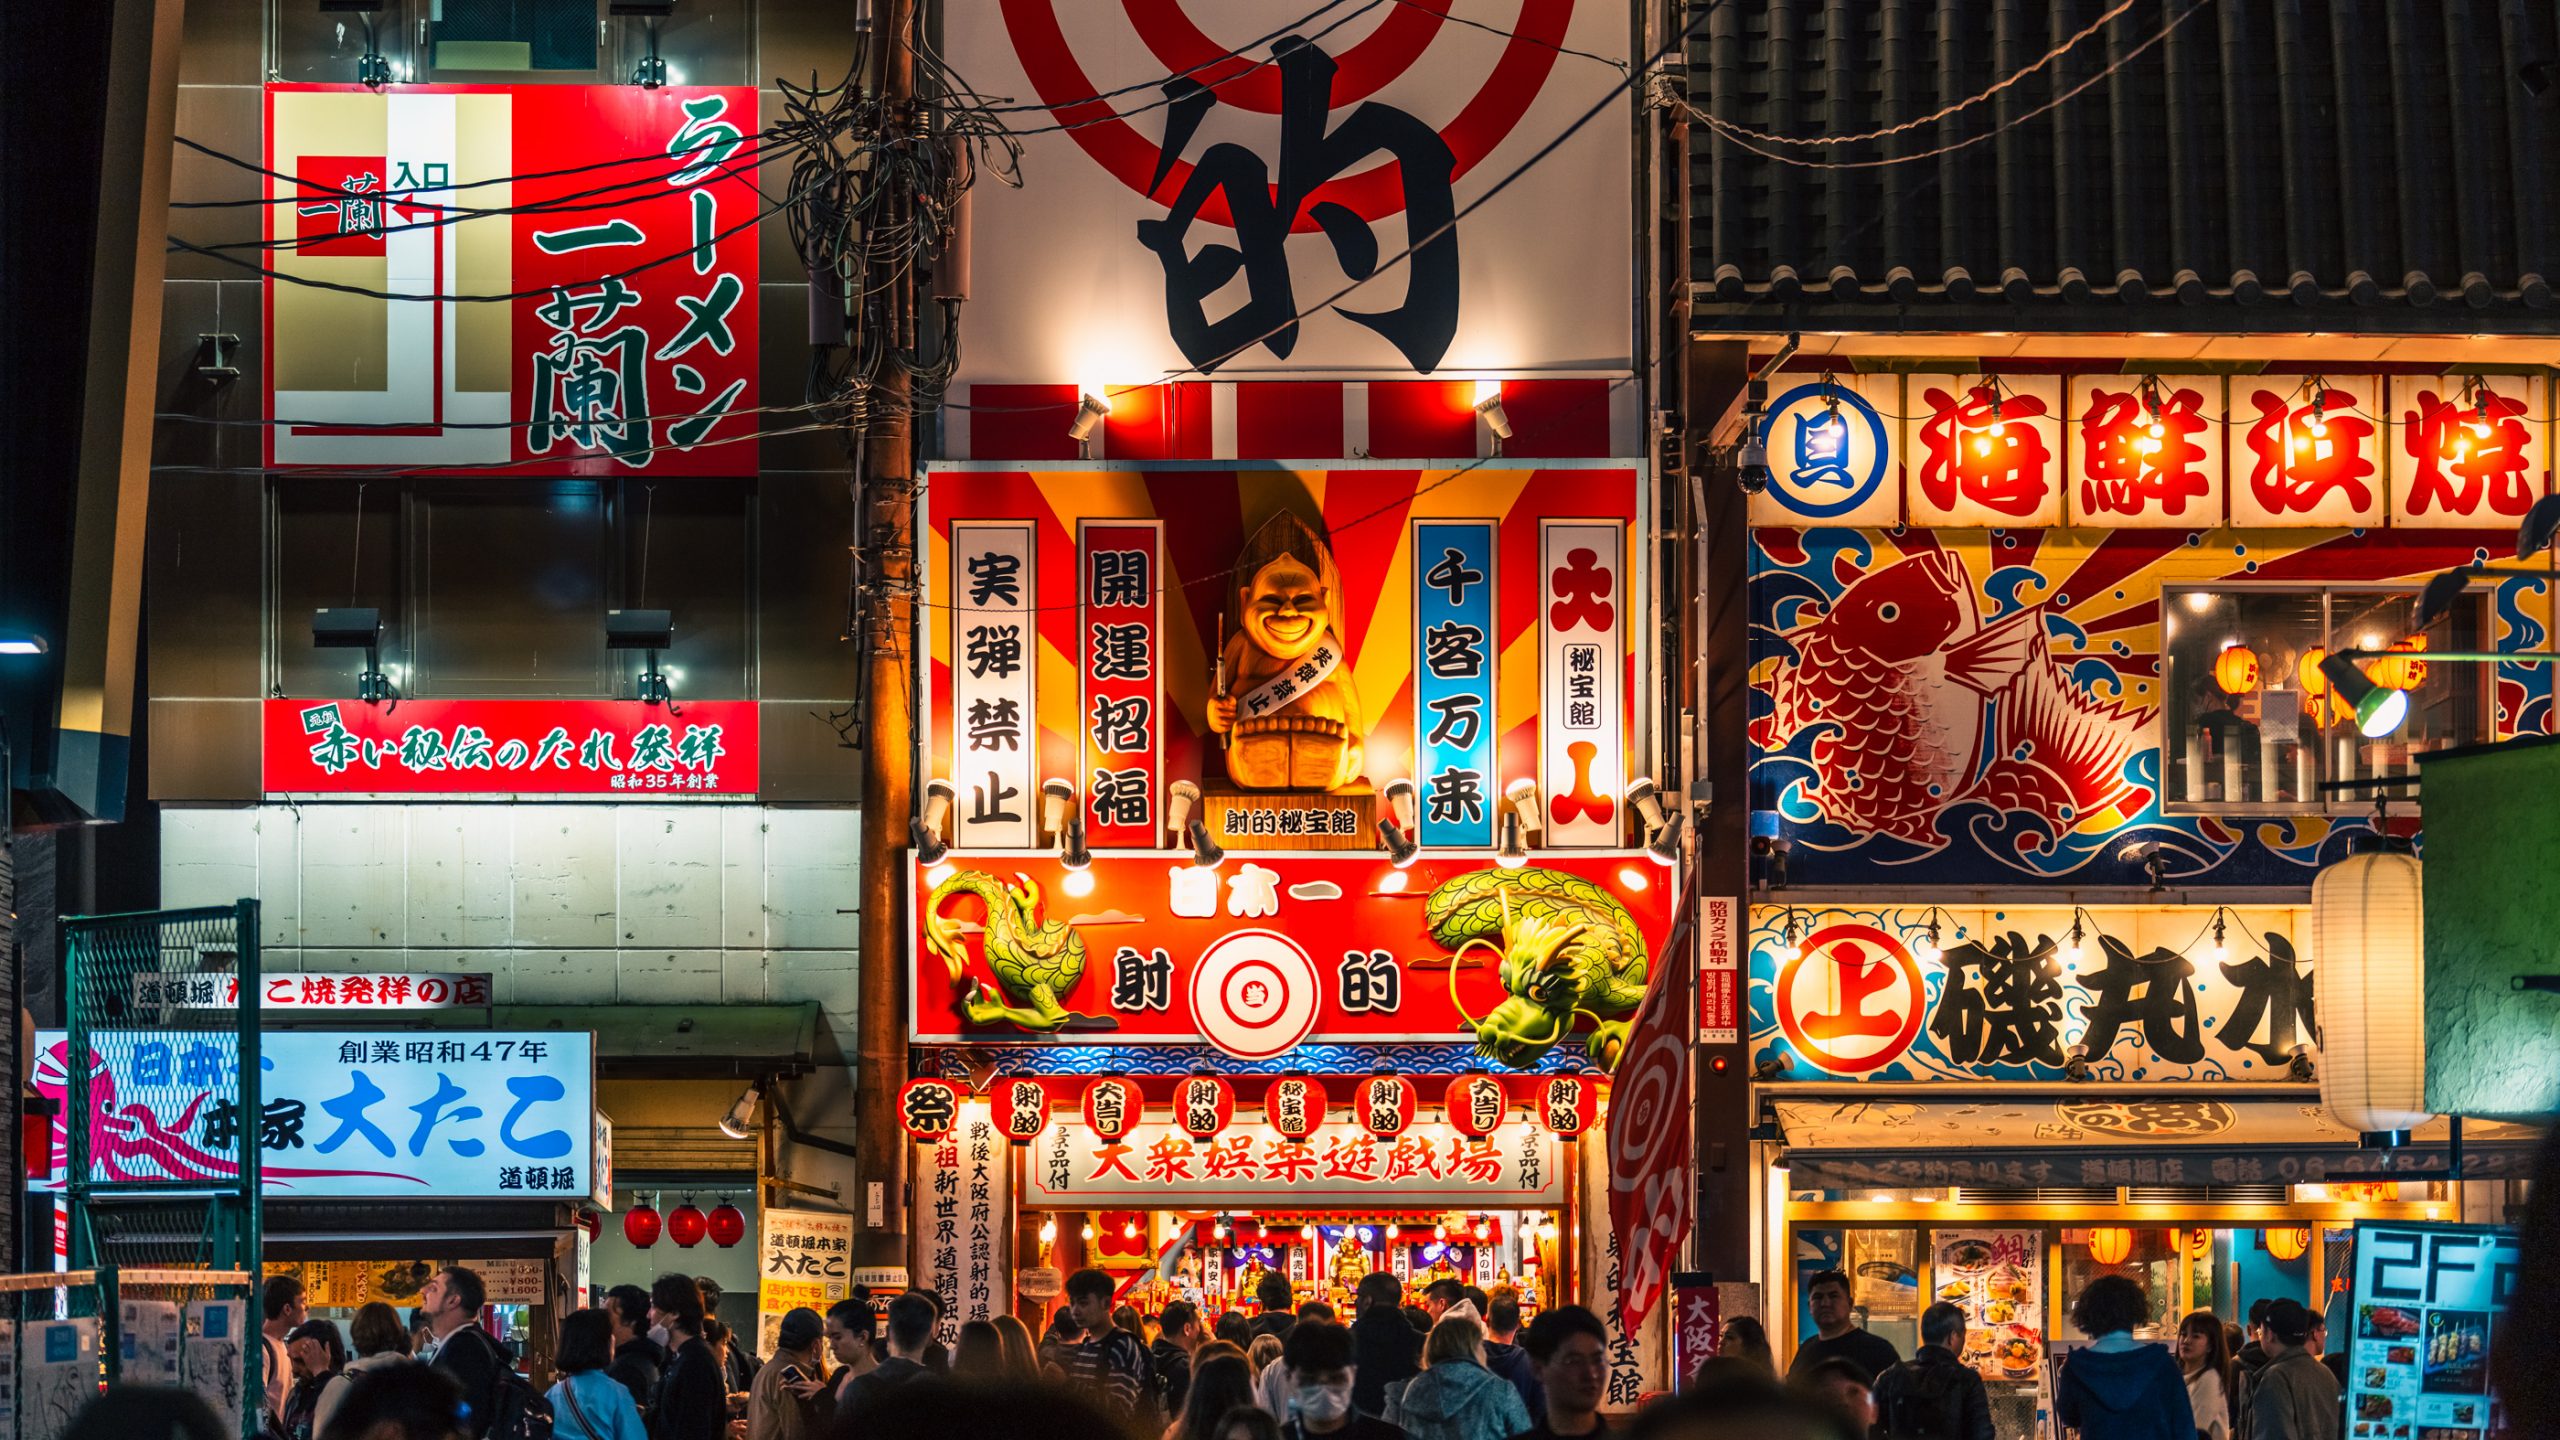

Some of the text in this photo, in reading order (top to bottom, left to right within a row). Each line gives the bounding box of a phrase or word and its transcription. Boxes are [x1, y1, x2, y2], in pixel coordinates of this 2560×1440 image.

[393, 161, 450, 189] 入口
[298, 172, 384, 239] 一蘭
[1137, 34, 1460, 375] 的
[654, 94, 747, 451] ラーメン
[526, 219, 654, 468] 一蘭
[1919, 387, 2531, 517] 海鮮浜焼
[966, 551, 1022, 825] 実弾禁止
[1090, 549, 1151, 828] 開運招福
[1425, 547, 1484, 824] 千客万来
[1569, 646, 1597, 728] 秘宝館
[309, 723, 727, 774] 赤い秘伝のたれ発祥
[609, 772, 720, 790] 昭和35年創業
[1224, 808, 1358, 836] 射的秘宝館
[1168, 863, 1343, 919] 日本一
[1708, 900, 1728, 965] 防犯カメラ作動中
[139, 980, 215, 1005] 道頓堀
[1111, 946, 1403, 1013] 射 的
[1800, 941, 1903, 1042] 上
[338, 1040, 549, 1064] 創業昭和47年
[202, 1070, 573, 1159] 本家 大たこ
[904, 1083, 955, 1134] 祭
[1094, 1081, 1123, 1134] 大当り
[1279, 1080, 1306, 1133] 秘宝館
[1471, 1077, 1501, 1131] 大当り
[499, 1166, 576, 1191] 道頓堀
[1048, 1126, 1071, 1191] 景品付
[1084, 1132, 1504, 1184] 大衆娯楽遊戯場
[1518, 1125, 1541, 1190] 景品付
[769, 1233, 847, 1252] 道頓堀本家
[969, 1121, 991, 1321] 戦後大阪府公認射的場
[768, 1250, 846, 1277] 大たこ
[1990, 1233, 2024, 1268] 鯛
[767, 1283, 822, 1299] 店内でも
